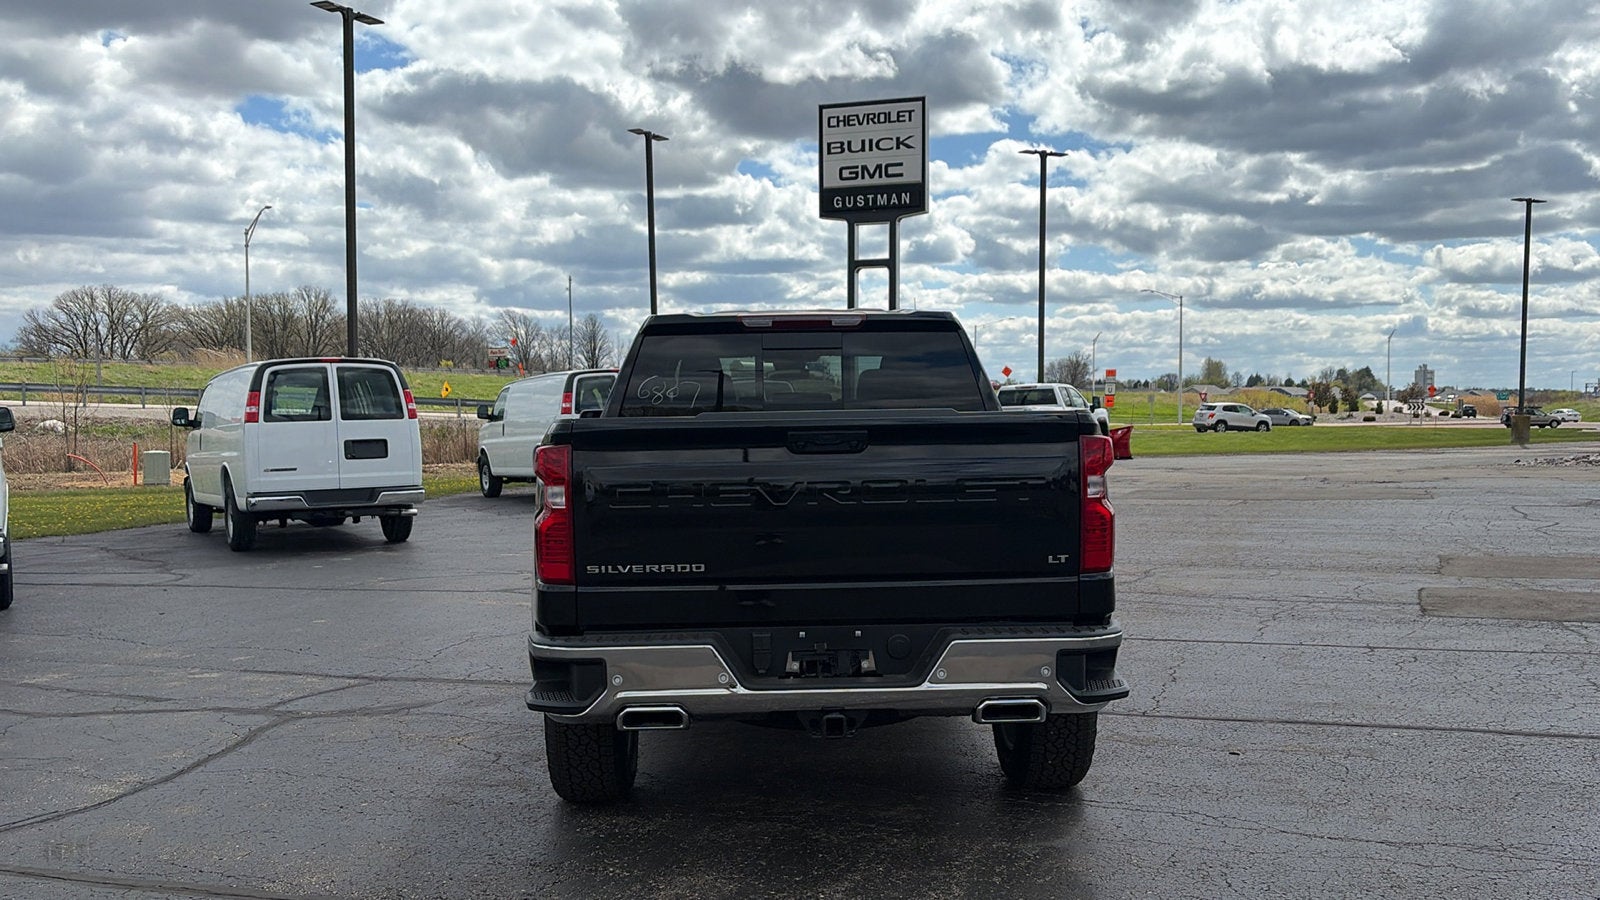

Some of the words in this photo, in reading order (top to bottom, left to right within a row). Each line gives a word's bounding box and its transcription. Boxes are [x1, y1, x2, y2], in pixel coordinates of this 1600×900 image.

[827, 109, 915, 129] CHEVROLET
[827, 135, 916, 155] BUICK
[838, 162, 904, 181] GMC
[833, 192, 910, 208] GUSTMAN
[606, 476, 1047, 509] CHEVROLET
[1047, 554, 1070, 564] LT
[586, 563, 706, 575] SILVERADO
